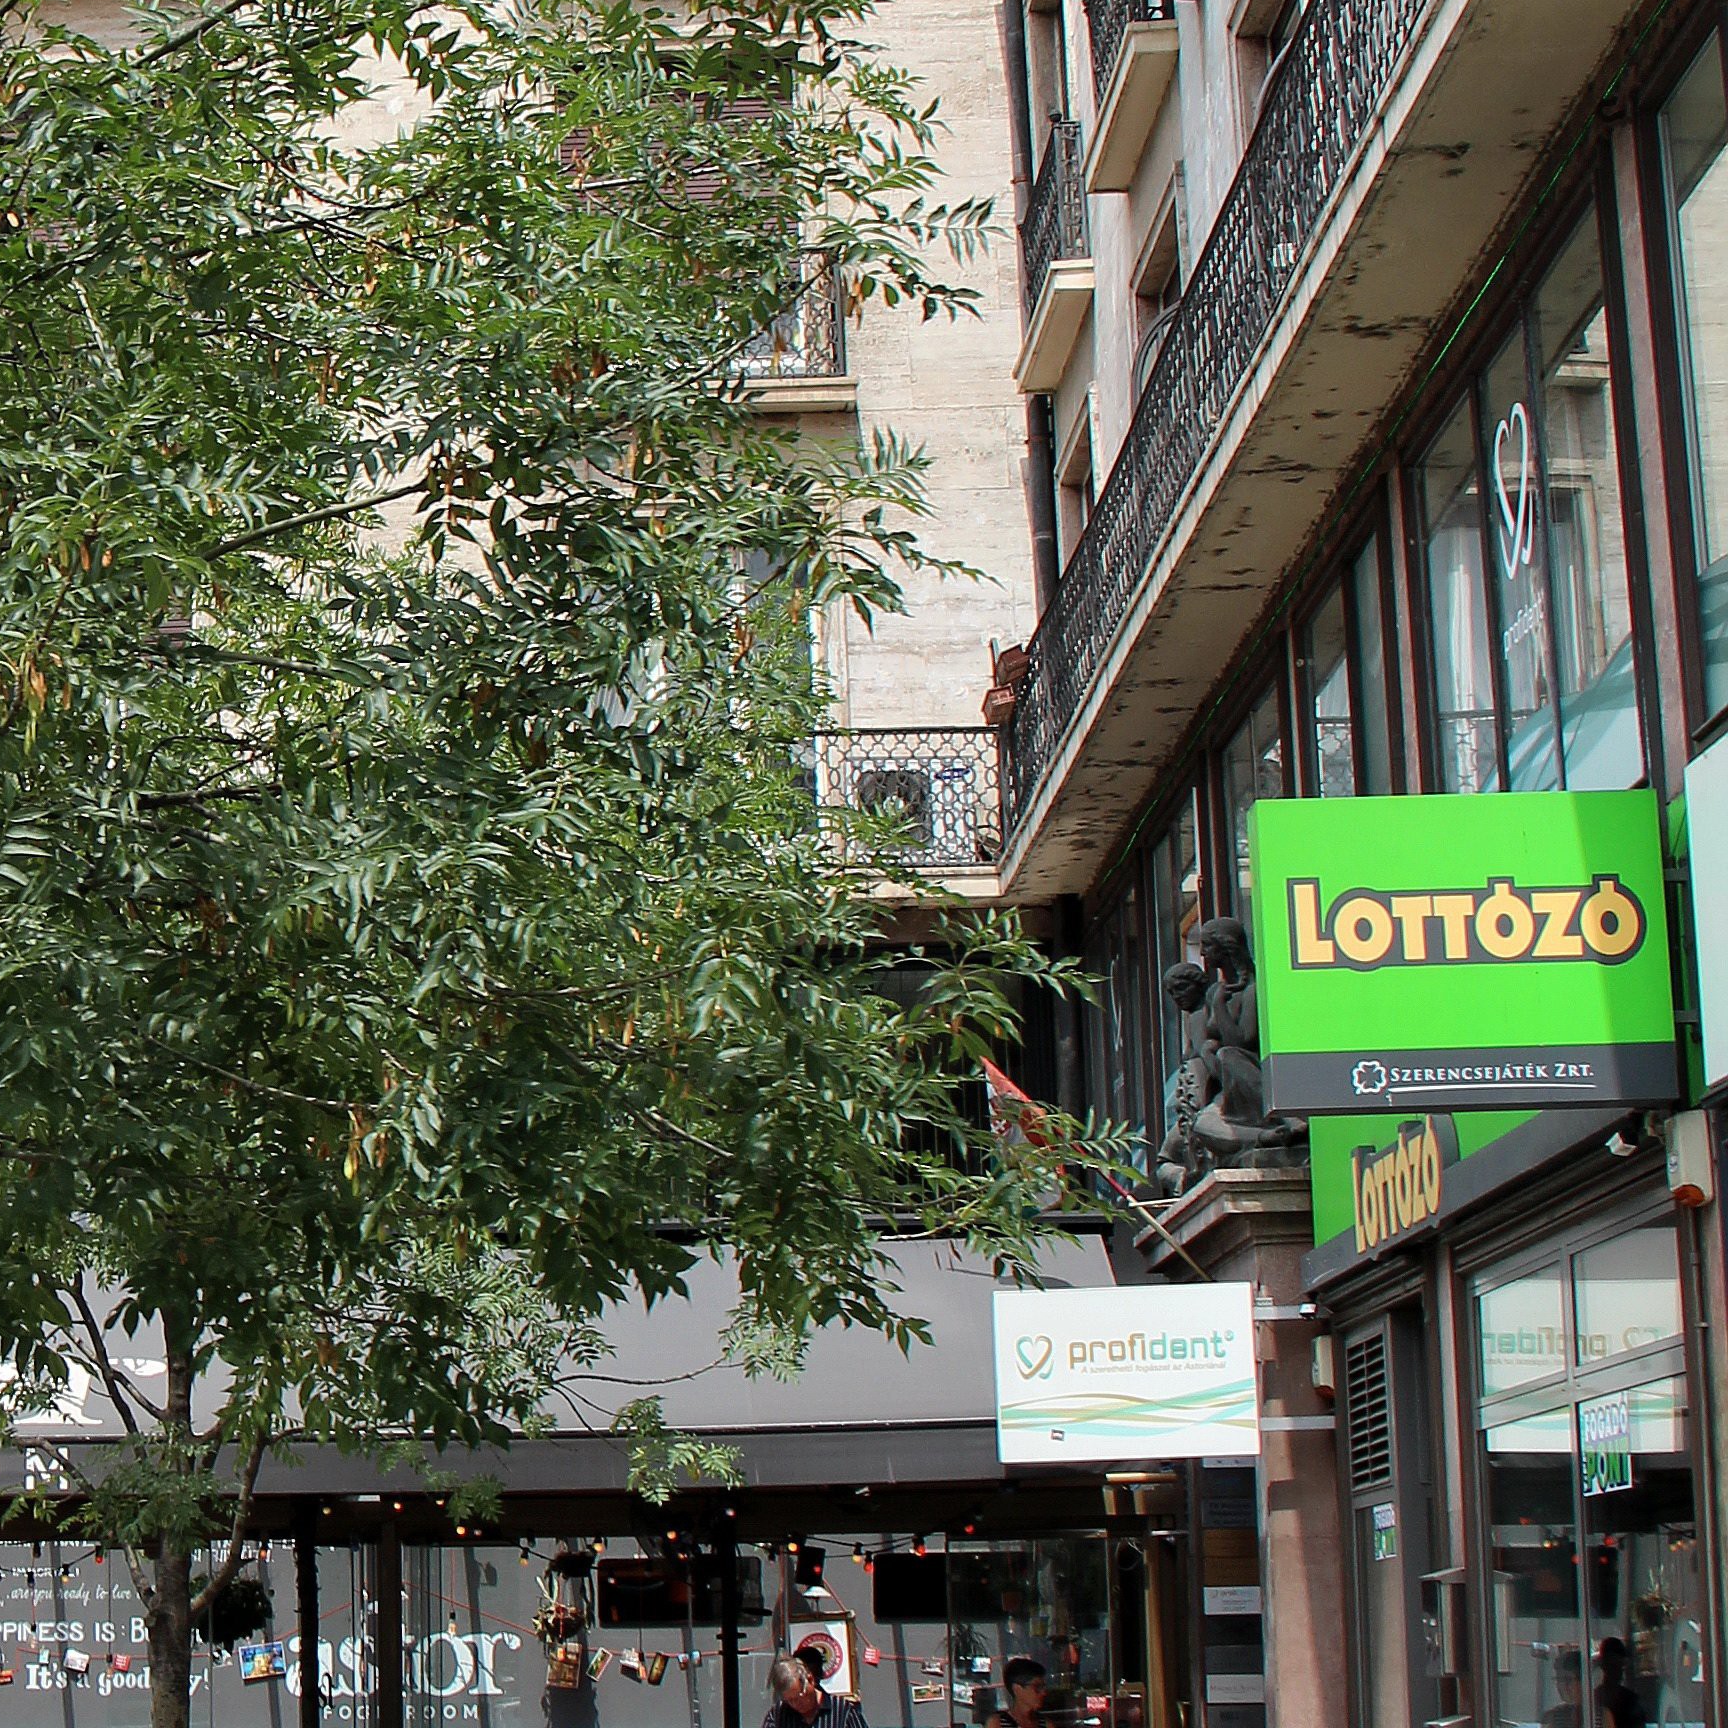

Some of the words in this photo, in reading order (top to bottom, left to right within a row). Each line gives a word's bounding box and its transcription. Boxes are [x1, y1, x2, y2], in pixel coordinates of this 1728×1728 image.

[1291, 878, 1641, 965] LOTTÓZÓ
[1389, 1062, 1549, 1083] SZERENCSEJÁTÉK
[1554, 1062, 1594, 1078] ZRT.
[1351, 1113, 1443, 1255] LOTTÓZÓ
[25, 1663, 69, 1691] It's
[96, 1666, 152, 1697] good
[322, 1704, 380, 1720] FOO
